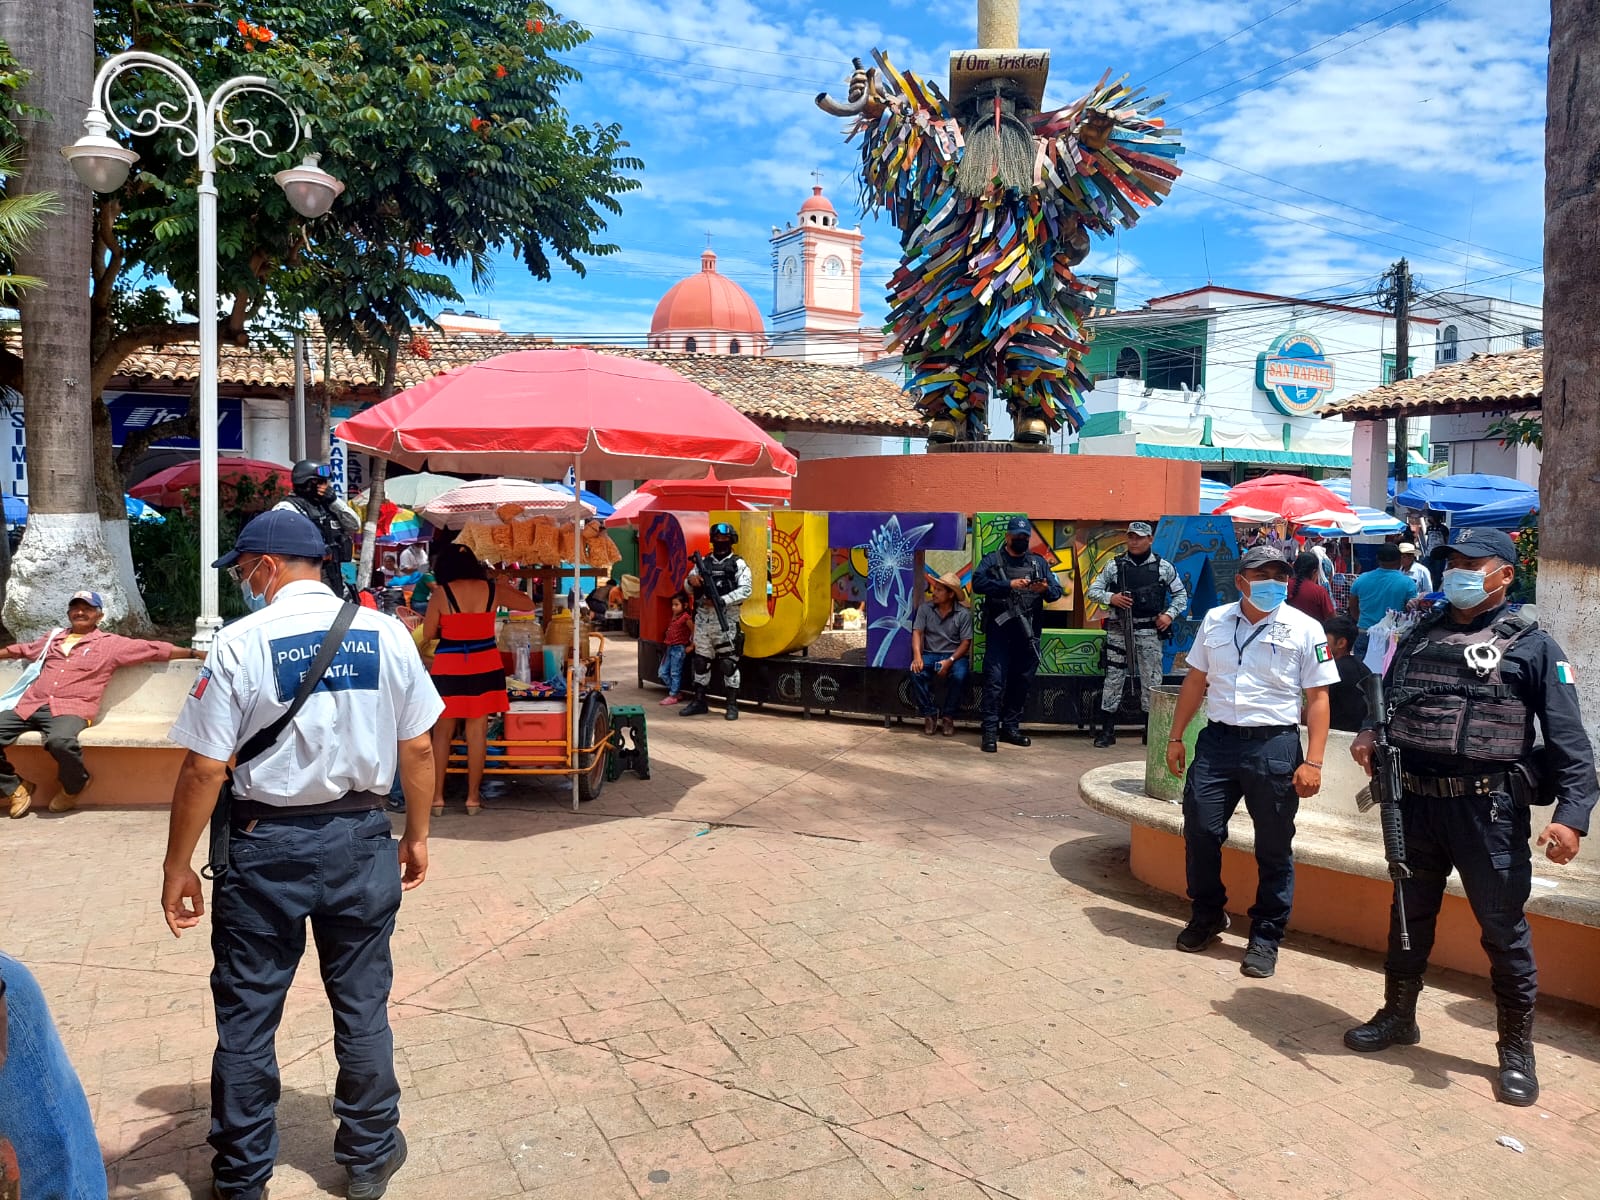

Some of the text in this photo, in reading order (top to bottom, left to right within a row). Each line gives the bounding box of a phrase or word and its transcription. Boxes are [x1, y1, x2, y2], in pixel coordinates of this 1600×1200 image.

[1269, 362, 1332, 383] SAN RAFAEL
[11, 411, 29, 503] SIMIL
[329, 433, 344, 499] FARMA
[277, 640, 376, 664] POLIC VIAL
[299, 663, 359, 683] EATAL
[777, 669, 840, 704] de
